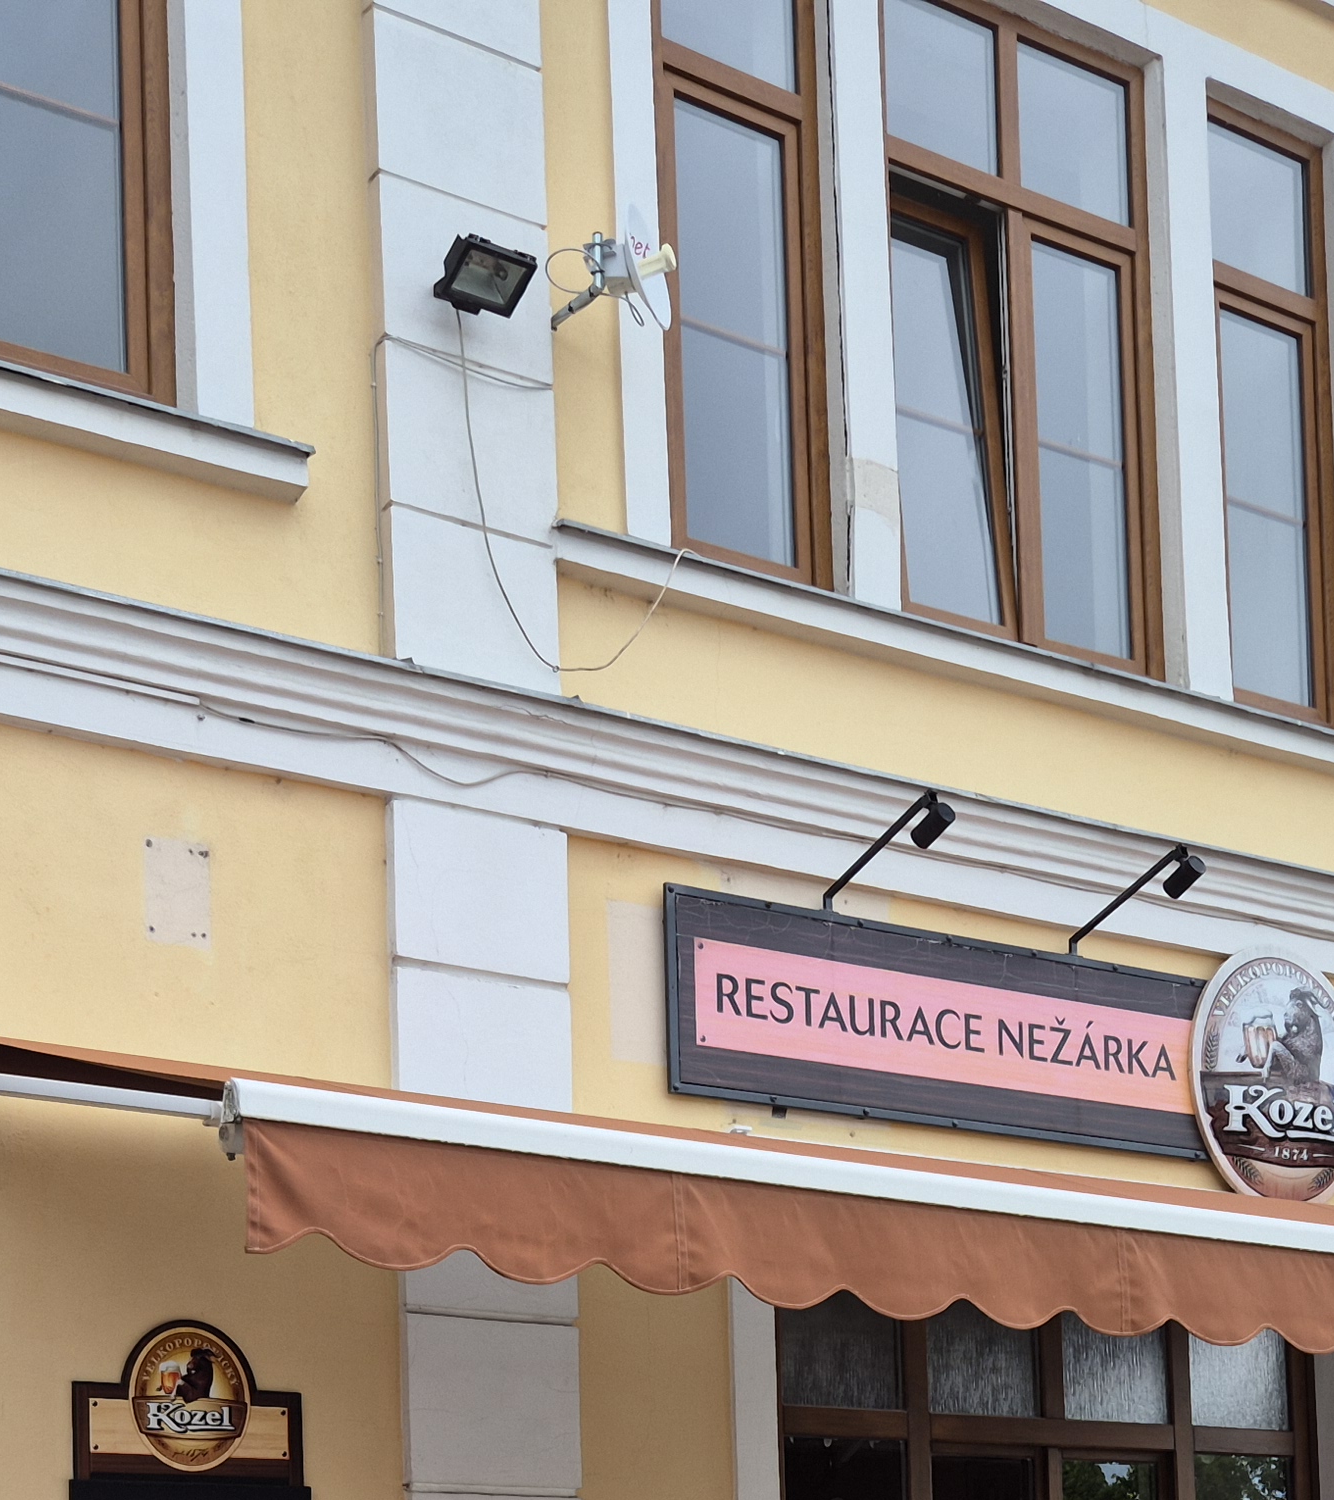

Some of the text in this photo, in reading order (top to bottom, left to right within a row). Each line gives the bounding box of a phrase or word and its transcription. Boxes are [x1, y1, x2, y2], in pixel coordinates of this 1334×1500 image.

[716, 973, 1177, 1081] RESTAURACE NEŽÁRKA
[1274, 1146, 1309, 1161] 1874
[147, 1402, 235, 1433] Kozel
